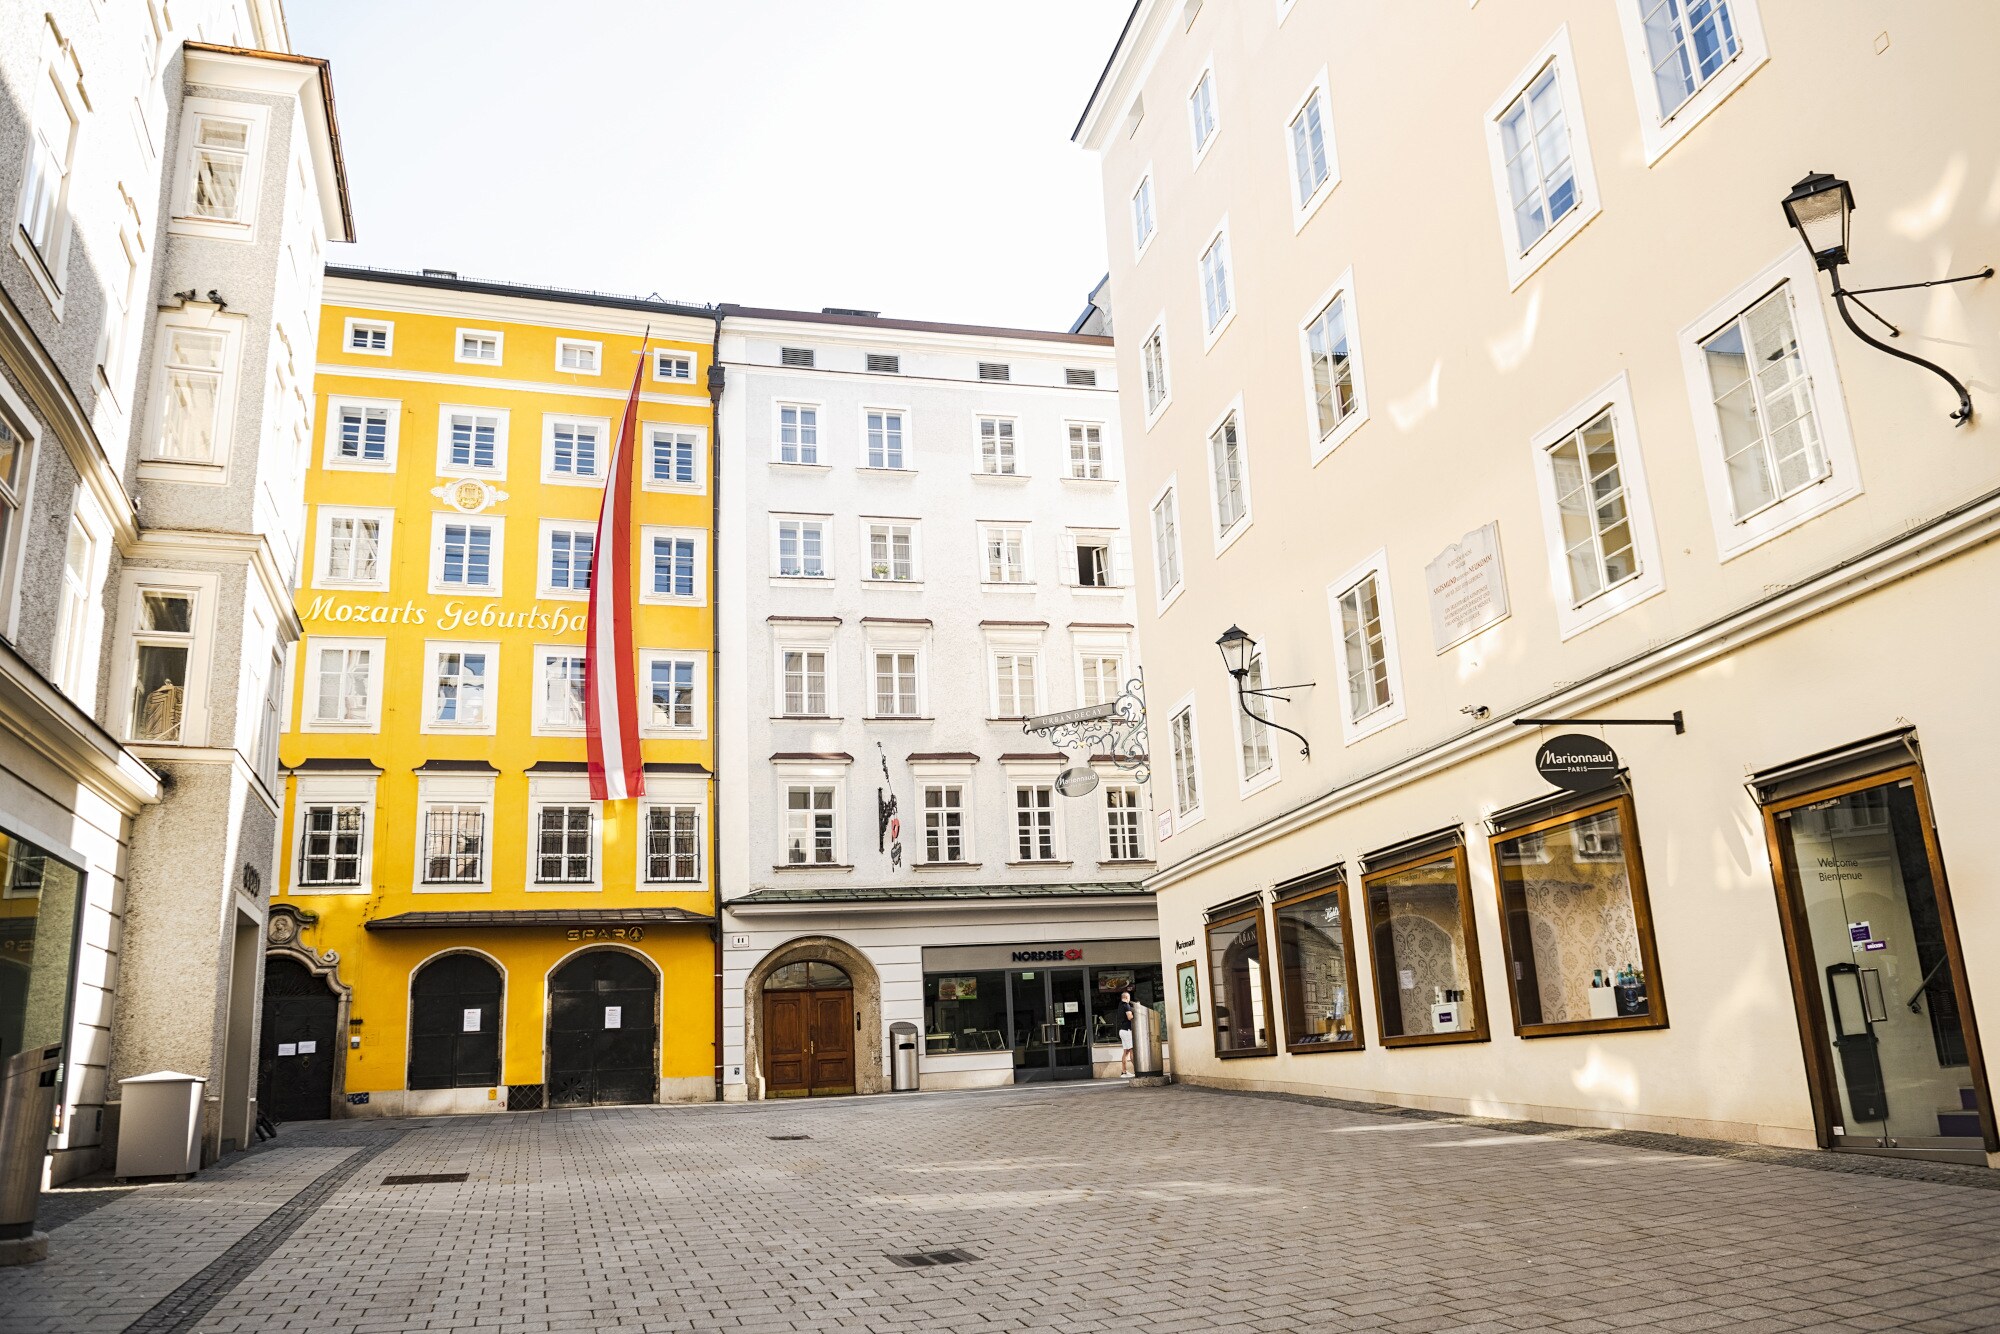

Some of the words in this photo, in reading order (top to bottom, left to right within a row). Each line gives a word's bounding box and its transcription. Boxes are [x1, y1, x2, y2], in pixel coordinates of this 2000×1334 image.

[300, 595, 428, 624] Mozarts
[437, 601, 586, 636] Geburtsha
[1042, 714, 1072, 725] URBAN
[1074, 708, 1102, 719] DECAY
[1540, 750, 1613, 768] Marionnaud
[1817, 857, 1859, 868] Welcome
[1818, 872, 1863, 882] Bienvenue
[567, 928, 627, 941] SPAR
[1012, 950, 1064, 961] NORDSEE
